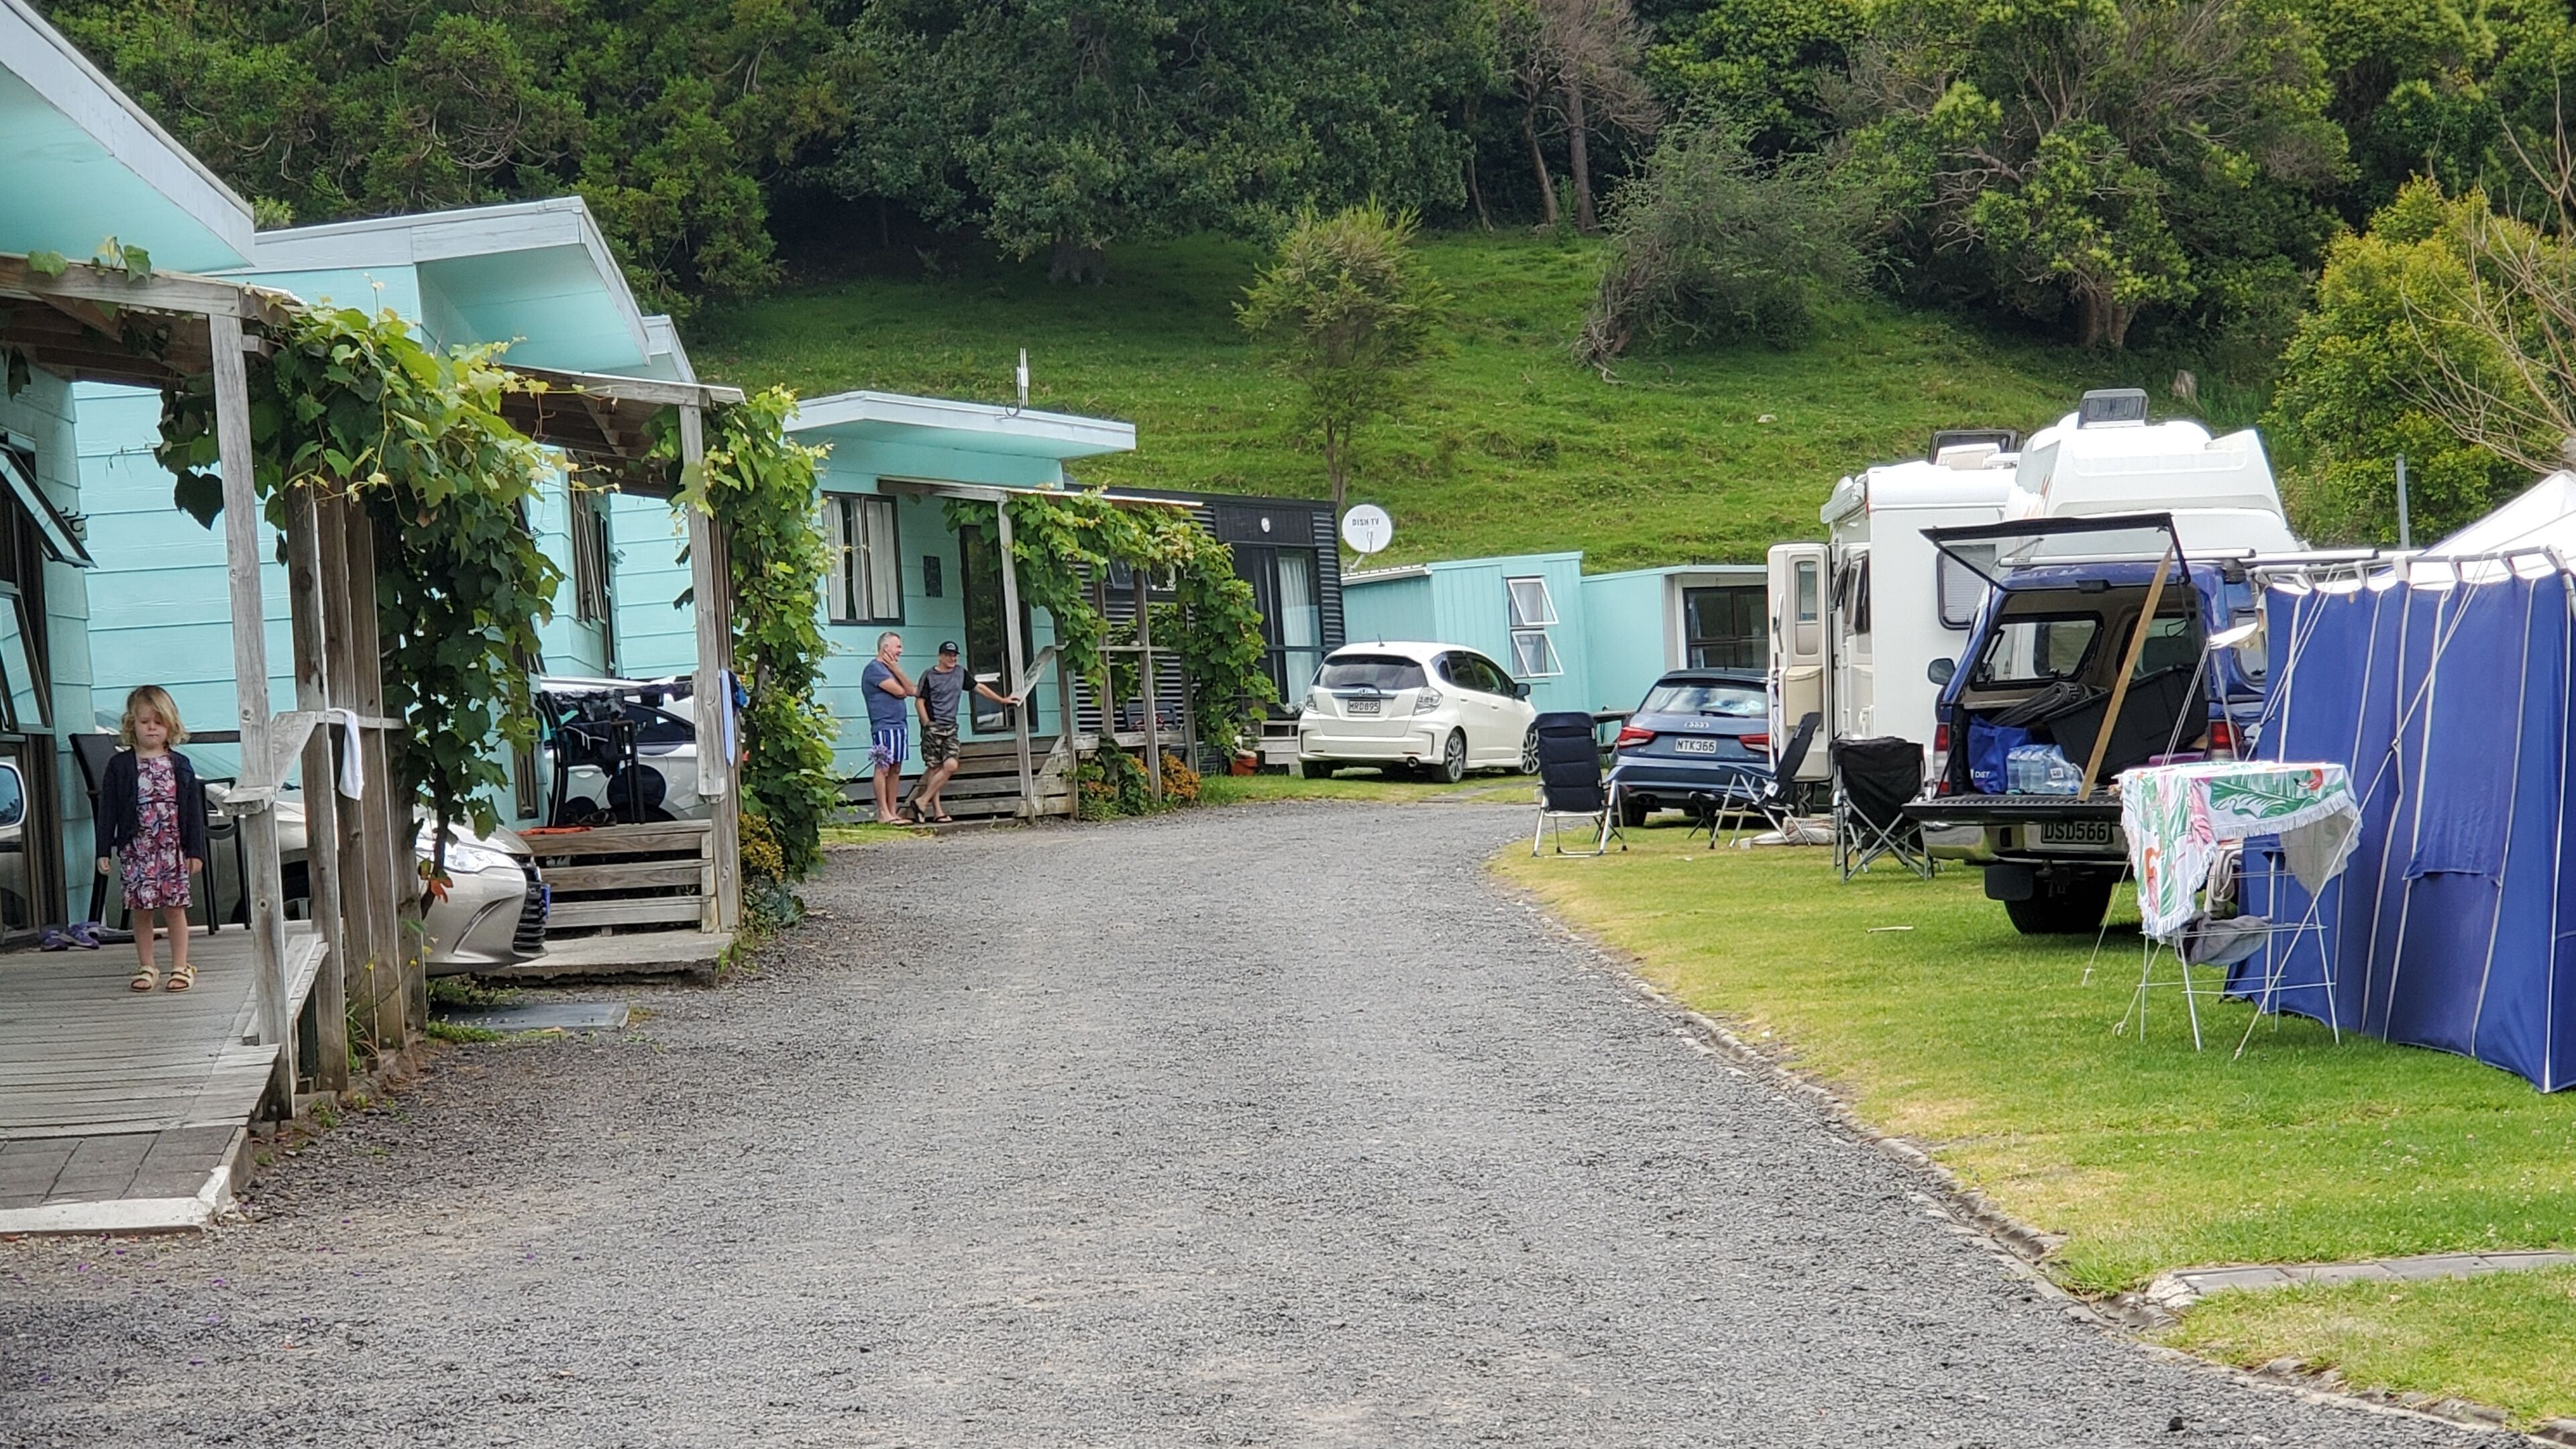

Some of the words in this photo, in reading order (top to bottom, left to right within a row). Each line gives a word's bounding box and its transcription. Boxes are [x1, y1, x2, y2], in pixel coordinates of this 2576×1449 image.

[1371, 517, 1379, 525] TV
[1677, 740, 1715, 751] NTK366
[2044, 823, 2106, 841] DSD566
